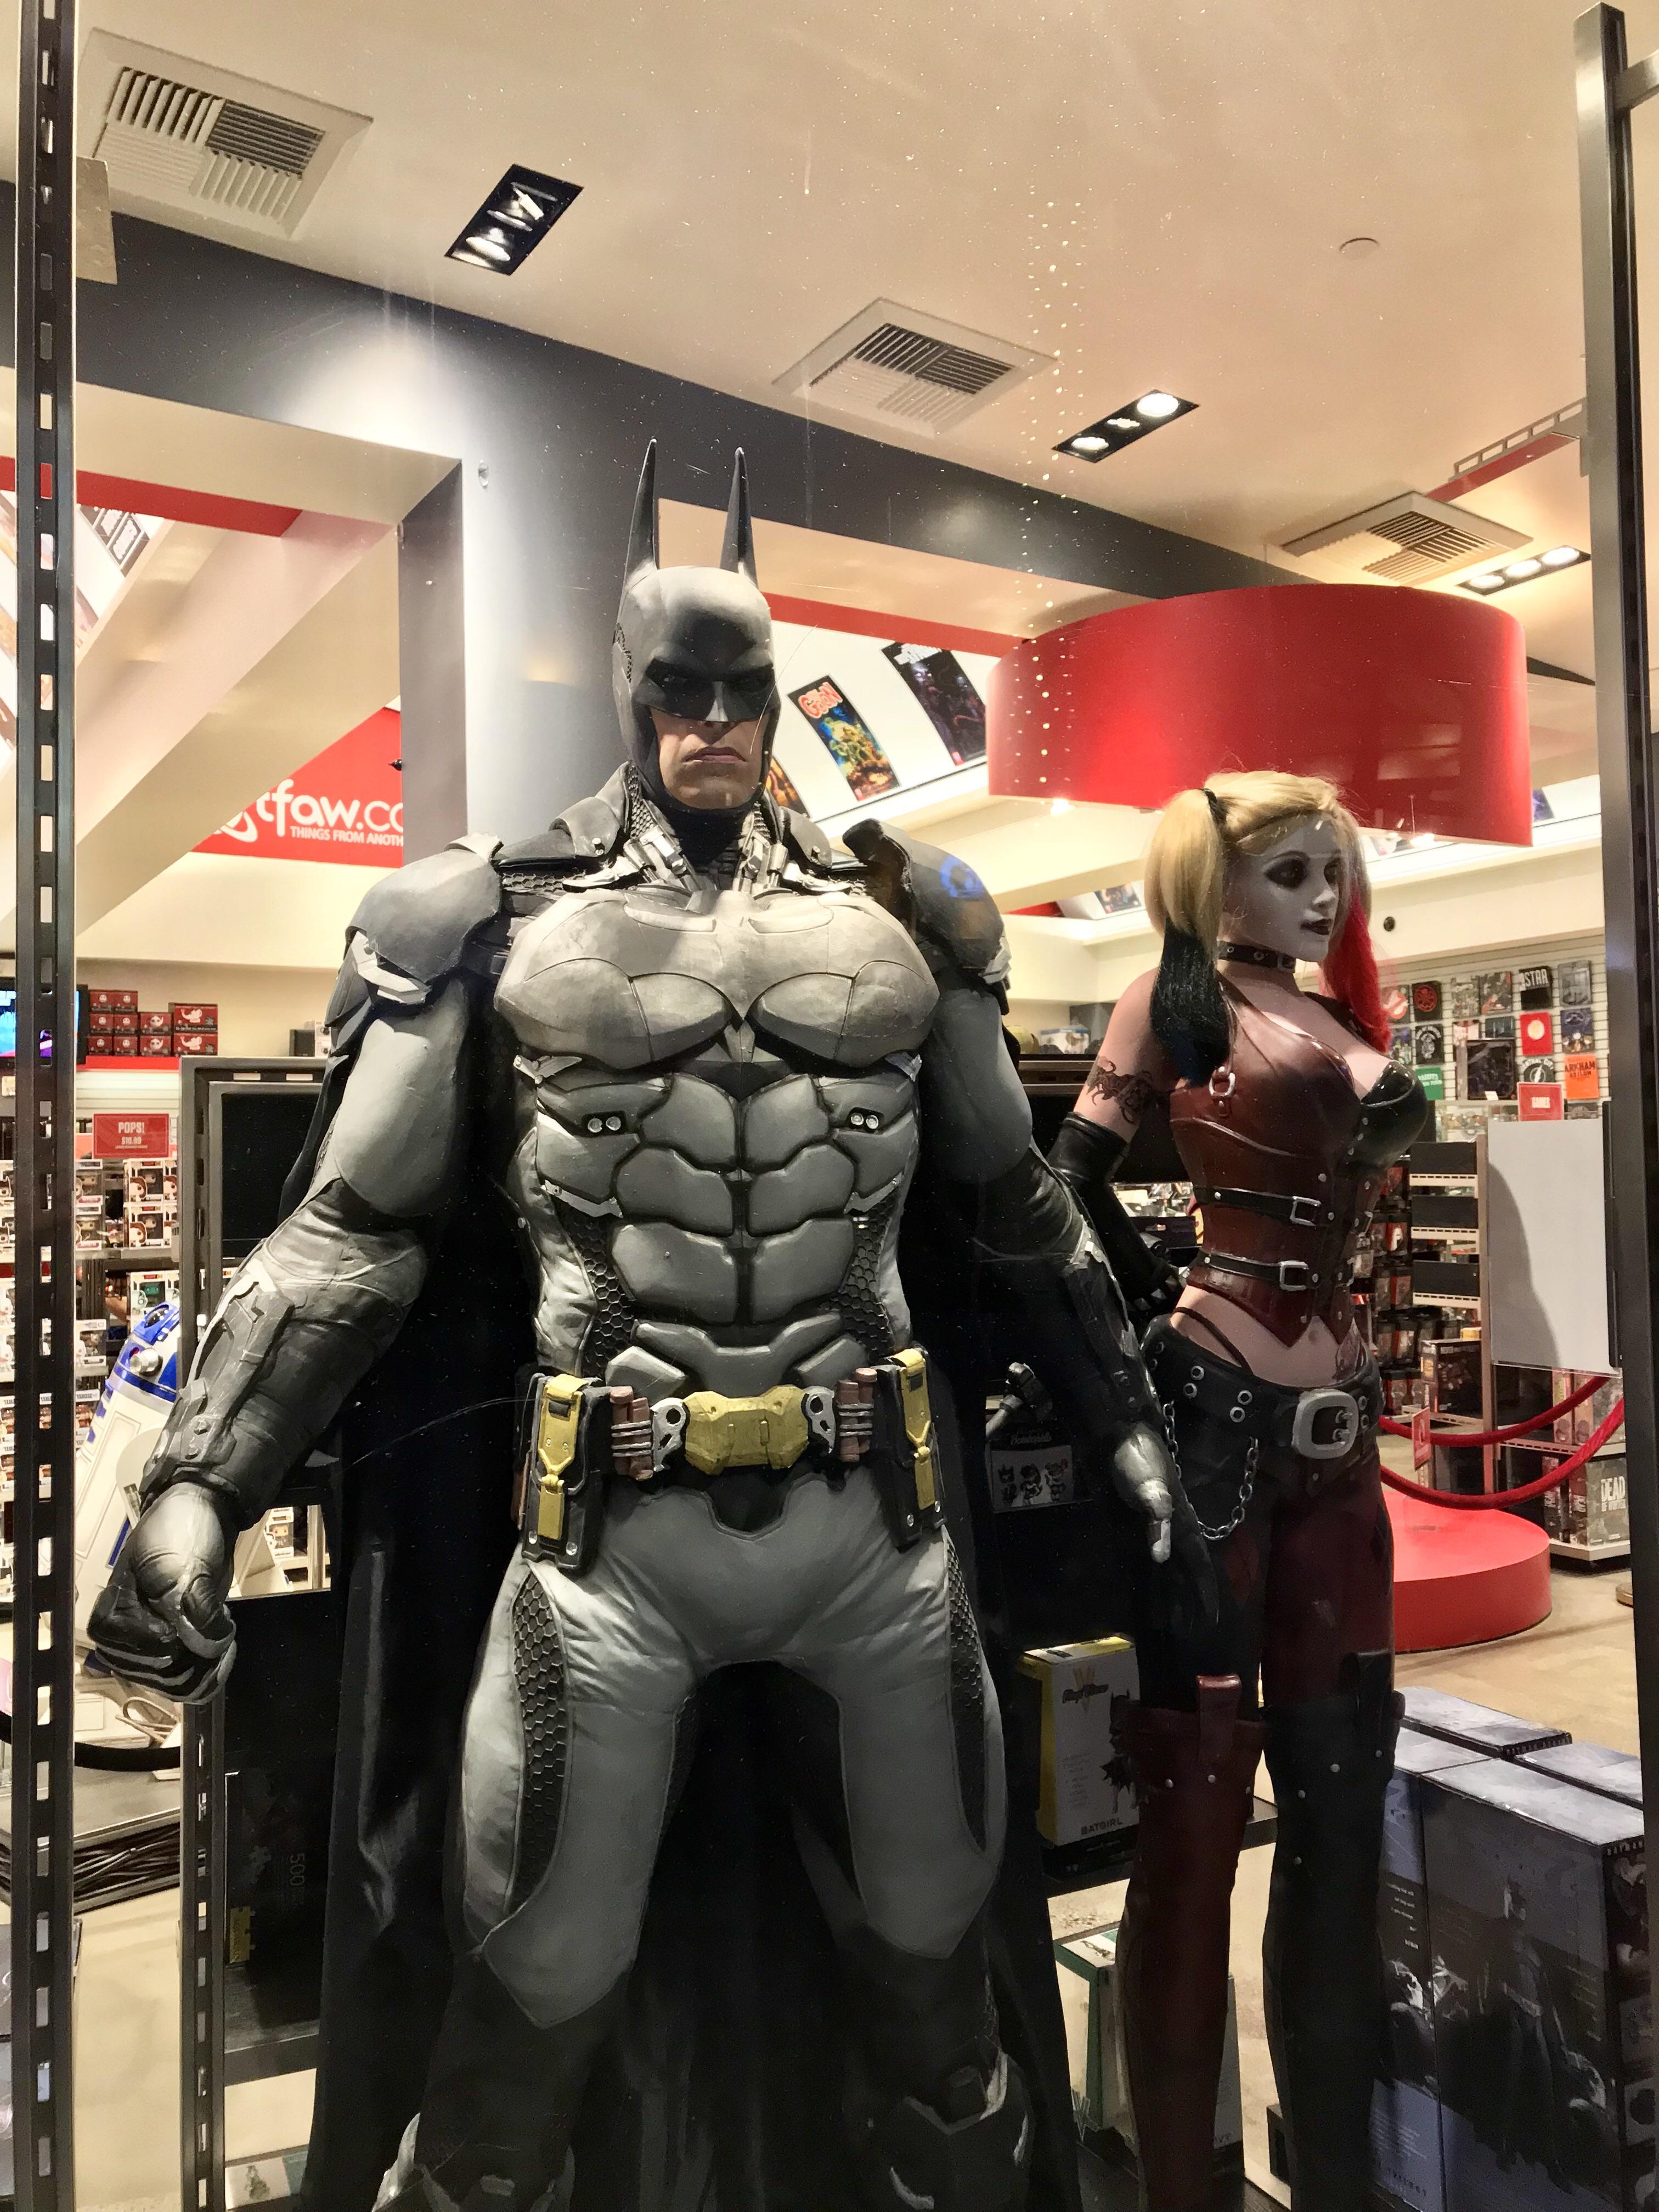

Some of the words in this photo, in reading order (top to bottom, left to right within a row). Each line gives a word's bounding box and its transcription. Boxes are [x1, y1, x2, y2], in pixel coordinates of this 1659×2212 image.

[290, 826, 330, 840] THINGS
[333, 830, 364, 844] FROM
[1565, 1061, 1595, 1072] ARKHAM
[118, 1122, 145, 1134] POPS!
[1601, 1476, 1626, 1502] DEAD
[1081, 1818, 1124, 1835] BATGIRL
[290, 1853, 306, 1887] 500
